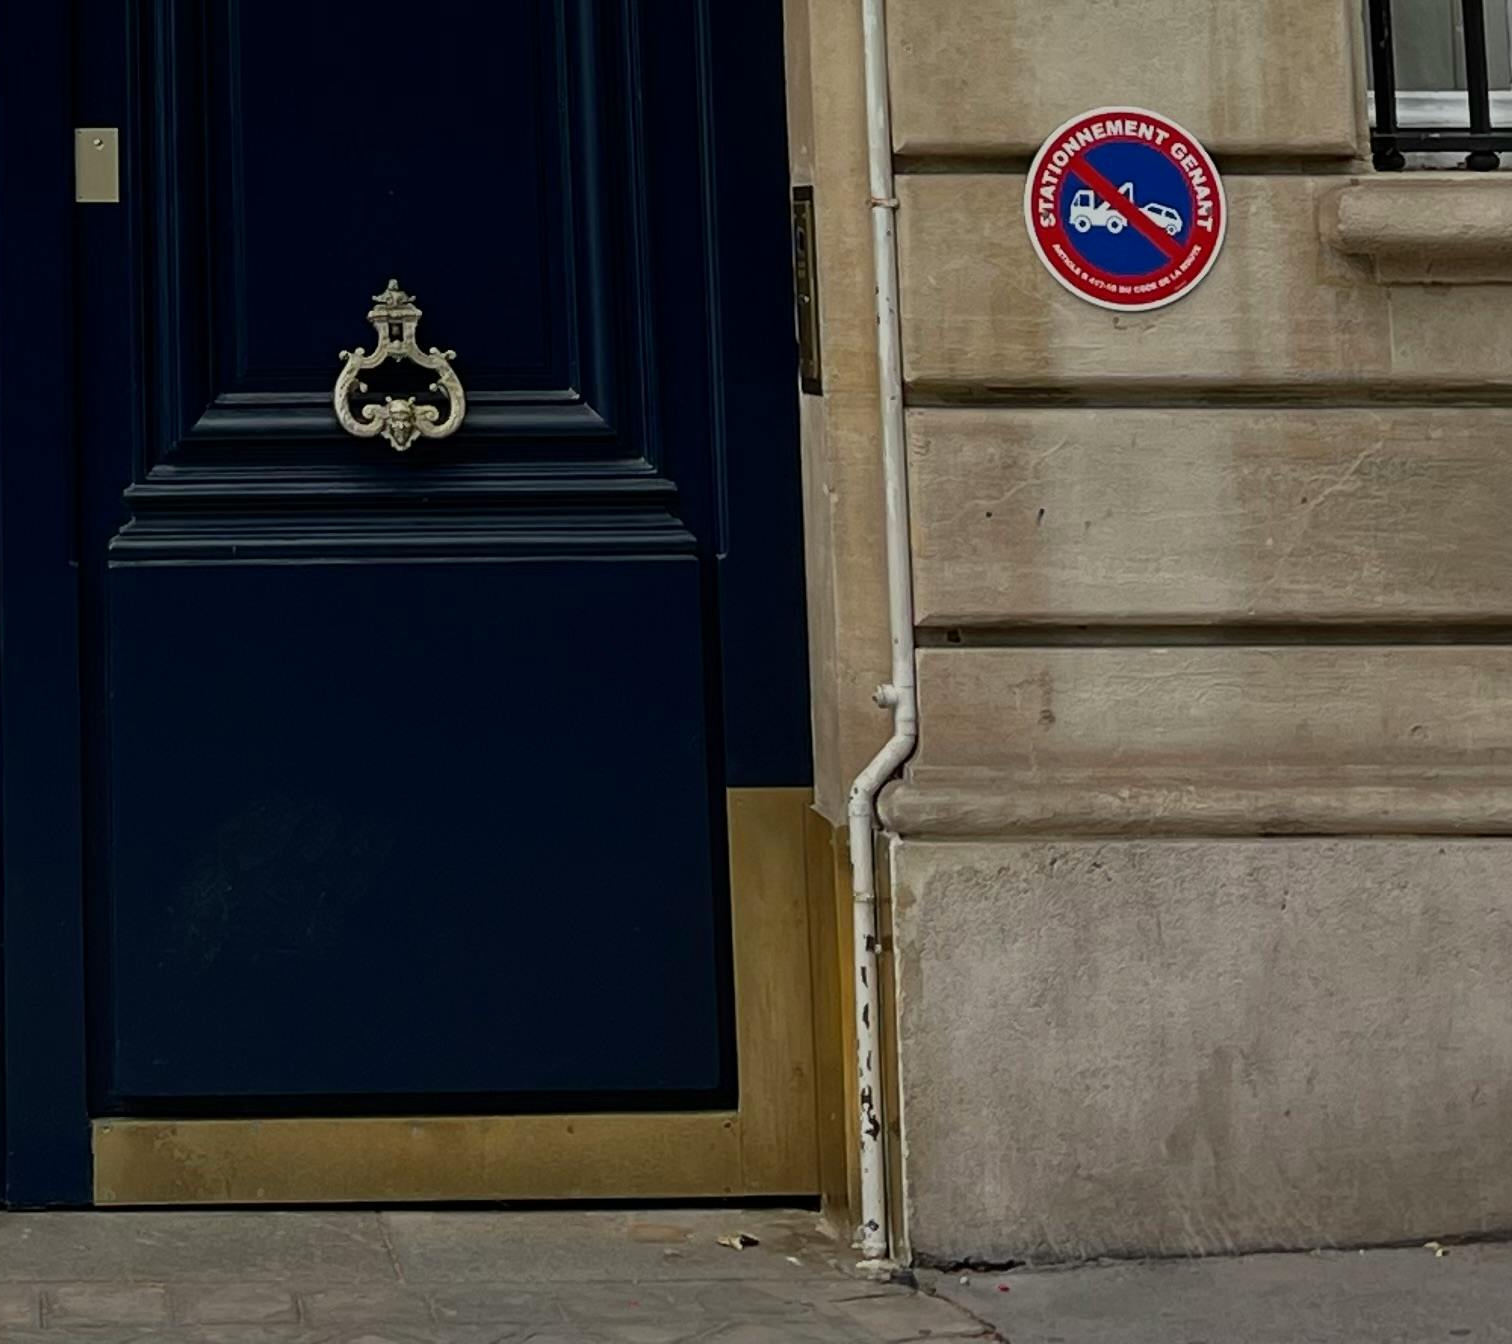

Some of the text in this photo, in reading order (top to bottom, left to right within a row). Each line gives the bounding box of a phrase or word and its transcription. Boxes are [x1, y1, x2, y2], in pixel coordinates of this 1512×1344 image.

[1039, 119, 1213, 232] STATIONNEMENT GENANT
[1169, 269, 1182, 281] LA
